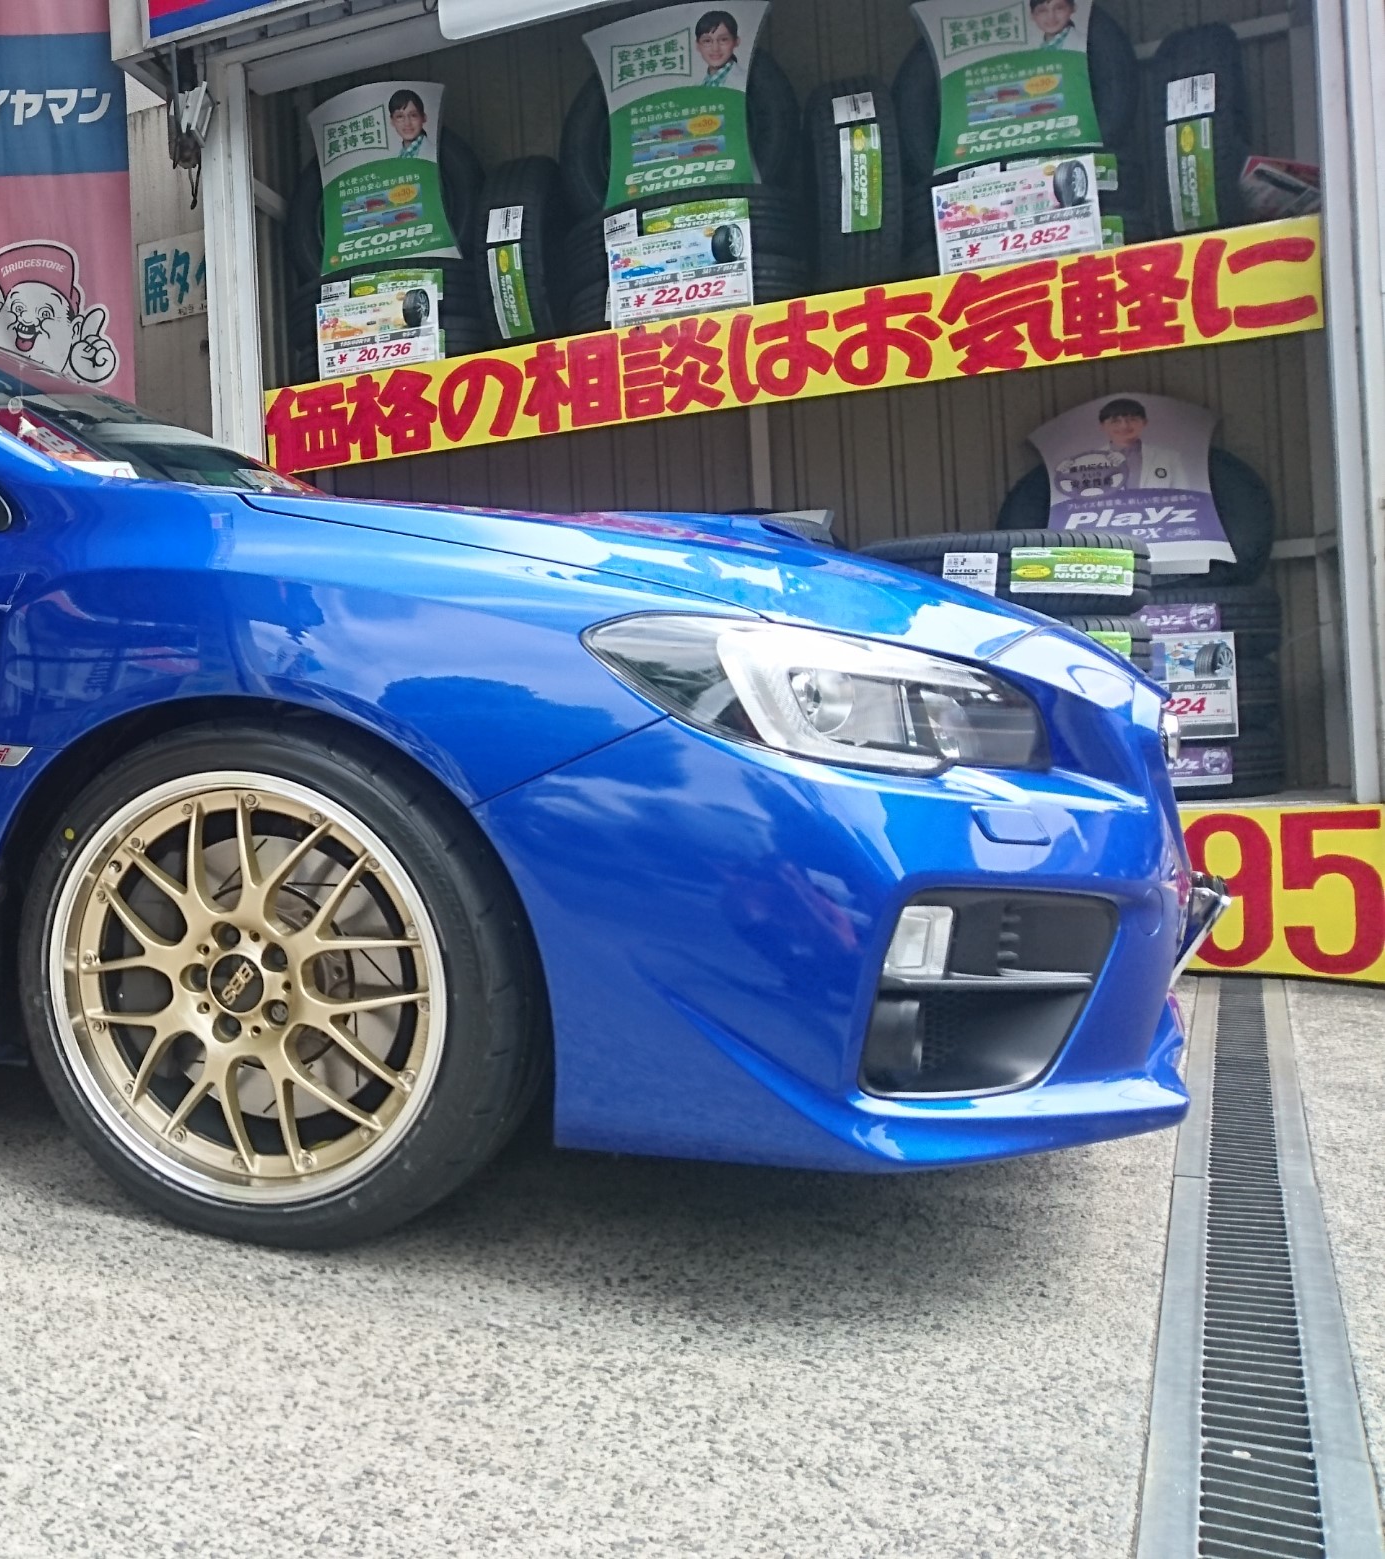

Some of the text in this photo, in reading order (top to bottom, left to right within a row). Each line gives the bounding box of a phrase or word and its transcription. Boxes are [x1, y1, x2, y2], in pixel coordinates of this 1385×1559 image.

[957, 115, 1079, 145] ECOPIA
[969, 135, 1042, 154] NH100
[624, 158, 736, 186] ECOPIA
[640, 175, 707, 194] NH100
[337, 223, 434, 253] ECOPIA
[341, 243, 397, 263] NH100
[399, 237, 425, 250] RV
[998, 224, 1071, 251] 12,852
[0, 258, 68, 278] BRIDGESTONE
[633, 293, 648, 308] ¥
[651, 279, 727, 306] 22,032
[265, 237, 1318, 475] 価格の相談はお気軽に
[337, 353, 348, 365] ¥
[357, 342, 412, 363] 20,736
[1053, 563, 1124, 575] ECOPIA
[1053, 572, 1100, 580] NH100
[221, 961, 255, 1006] BBS
